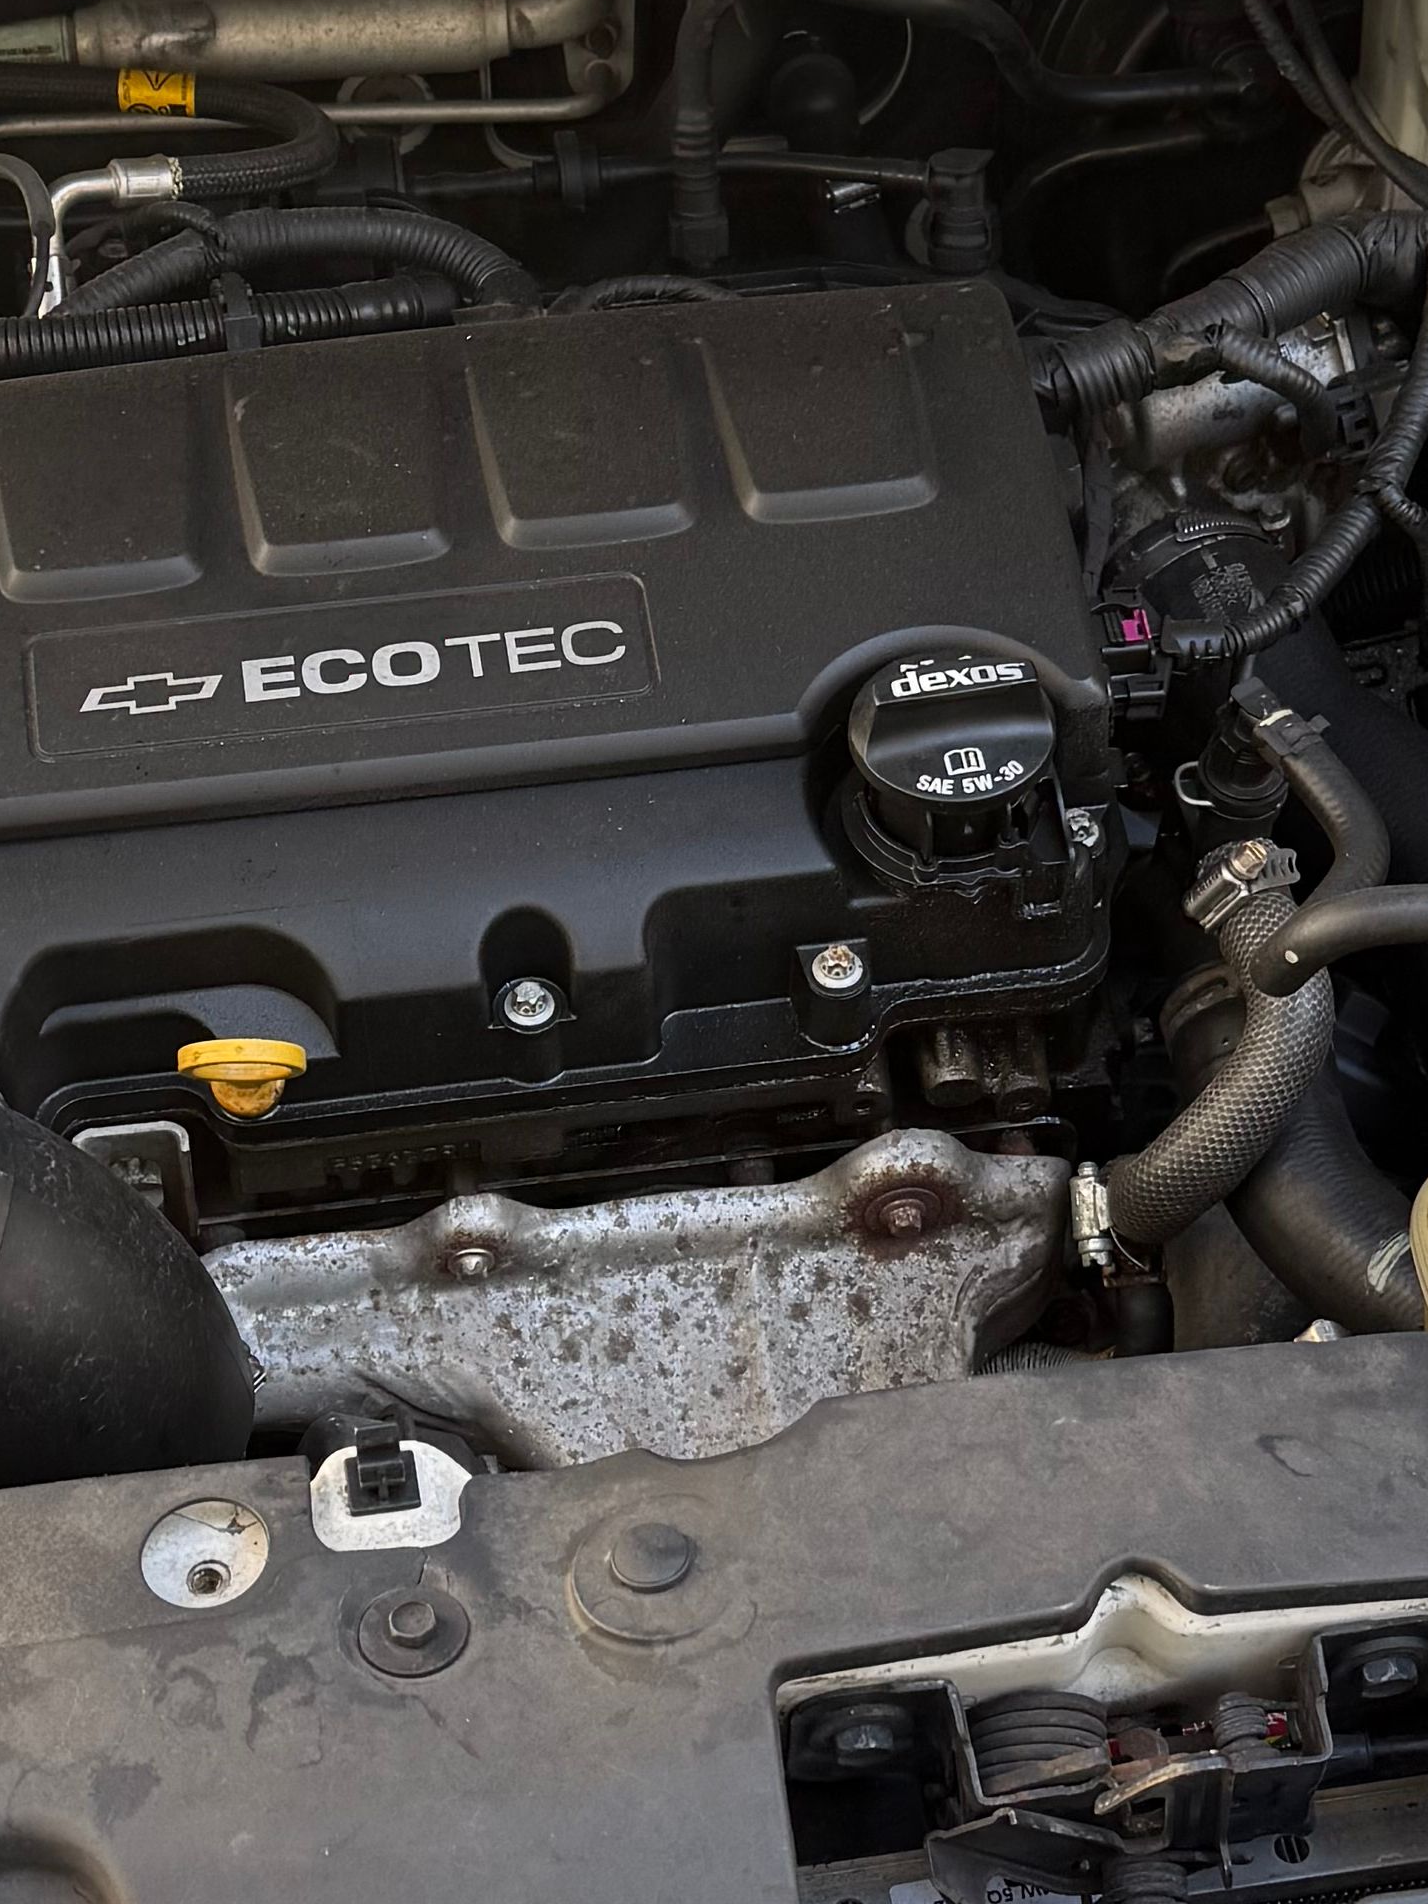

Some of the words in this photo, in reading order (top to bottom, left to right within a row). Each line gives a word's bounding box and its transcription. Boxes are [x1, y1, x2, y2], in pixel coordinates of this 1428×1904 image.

[242, 620, 627, 703] ECOTEC
[891, 662, 1025, 697] dexos
[916, 774, 954, 795] SAE
[962, 760, 1024, 794] 5W-30
